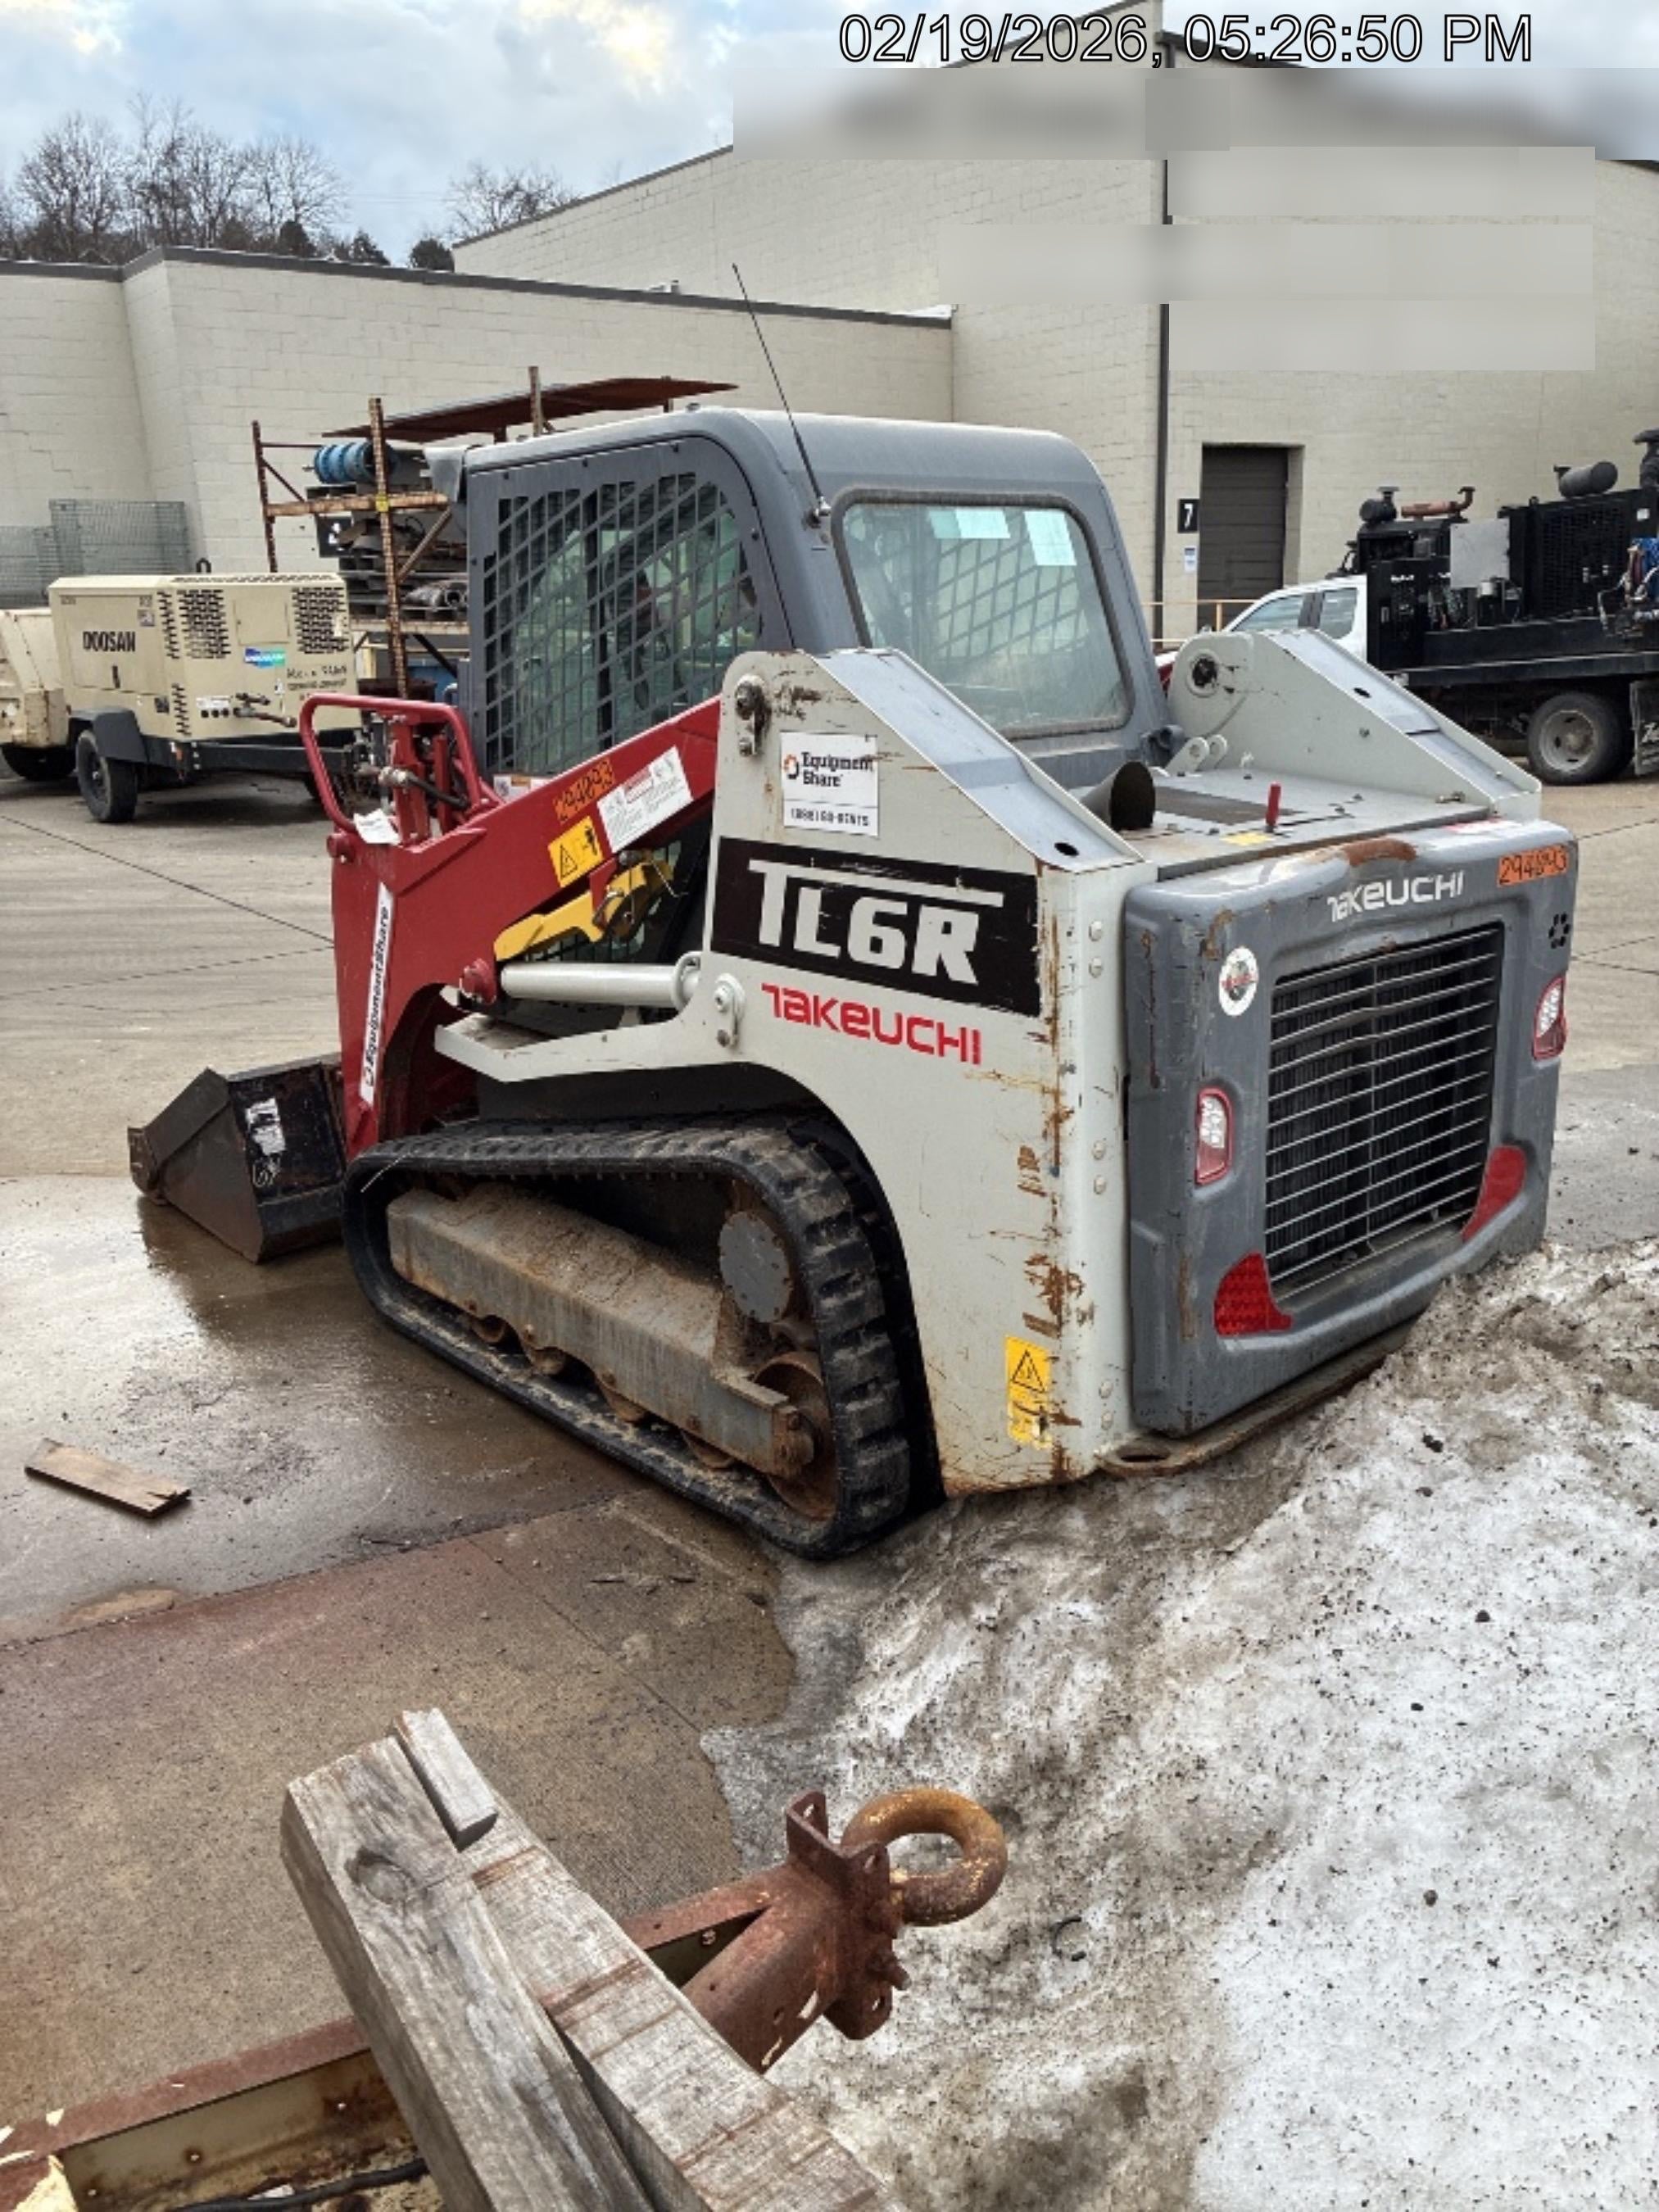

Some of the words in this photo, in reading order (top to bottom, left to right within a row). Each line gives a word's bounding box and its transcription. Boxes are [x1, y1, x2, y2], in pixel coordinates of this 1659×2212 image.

[1183, 502, 1194, 529] 7
[83, 630, 135, 652] DOOSAN
[803, 770, 841, 787] Share
[749, 859, 1004, 985] TL6R
